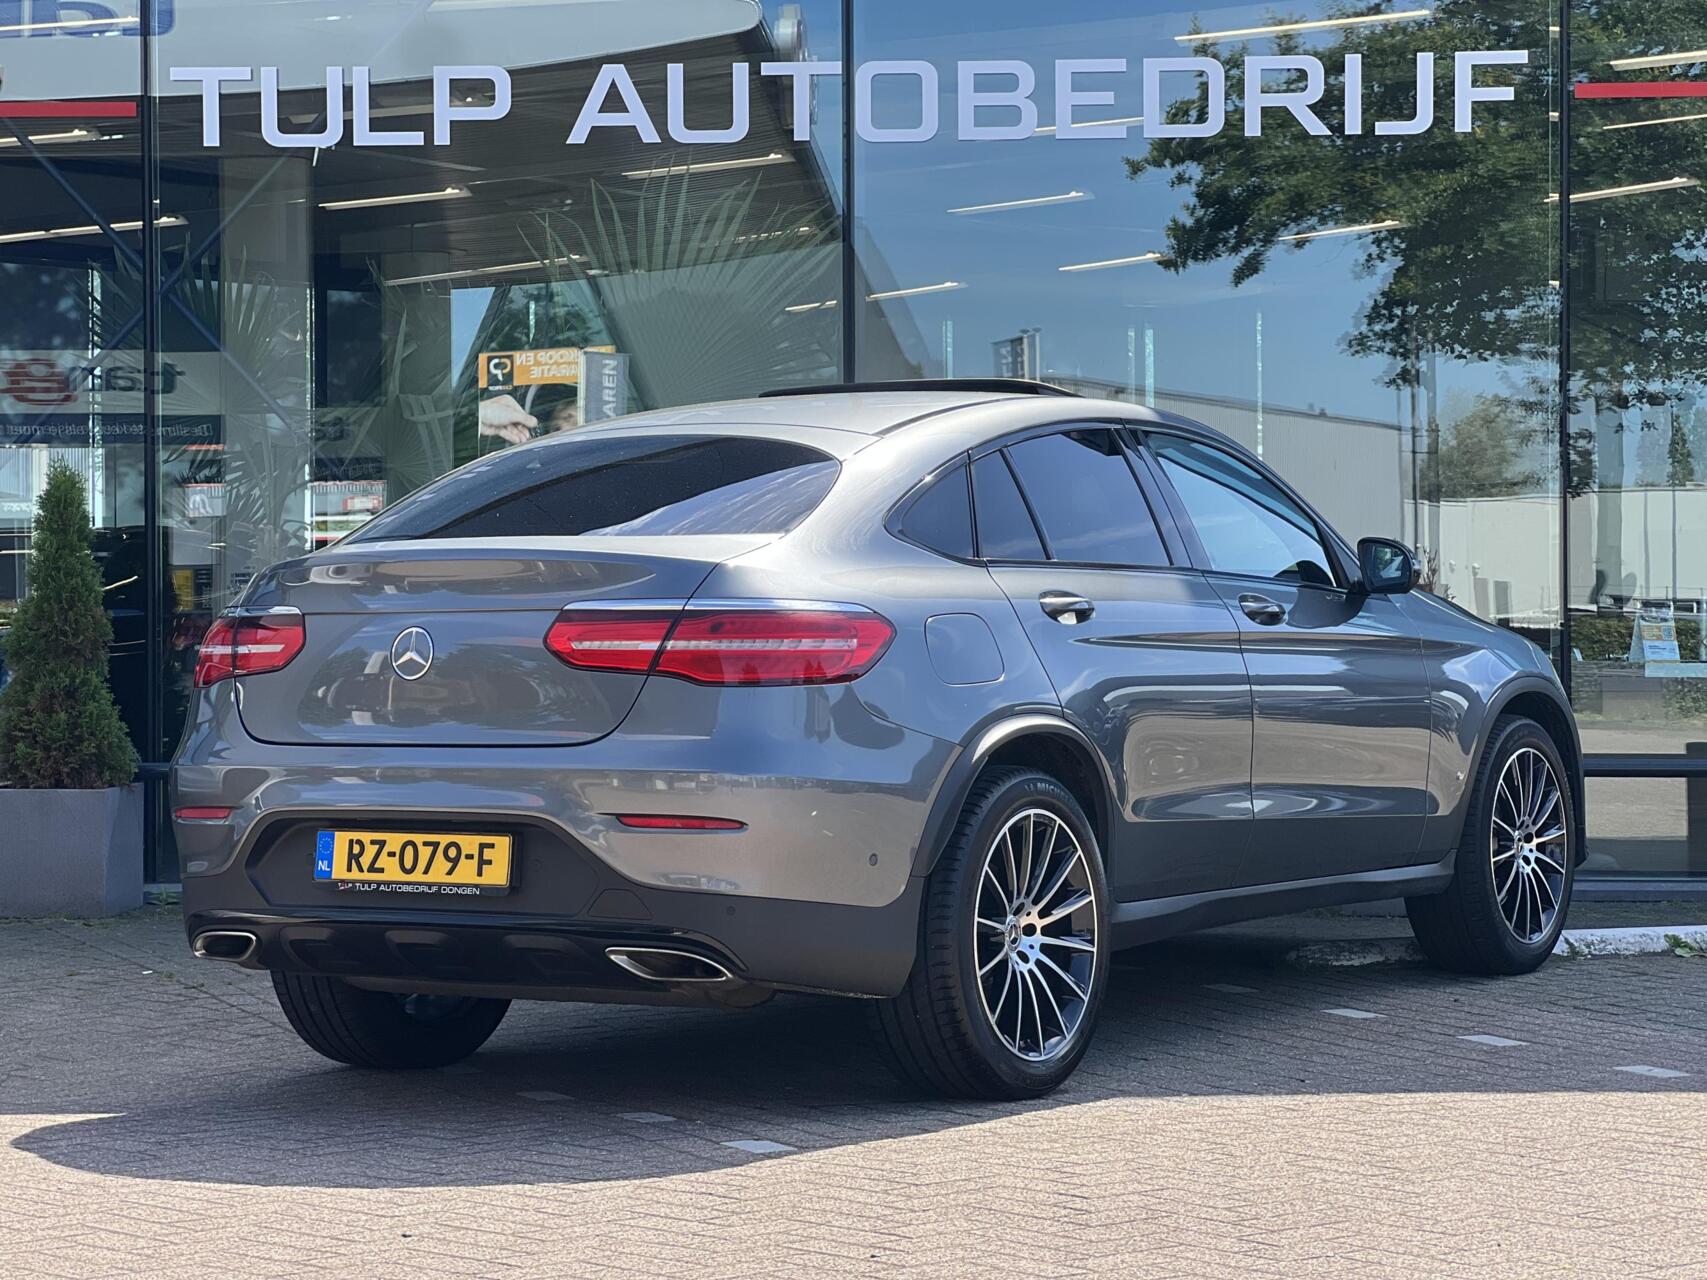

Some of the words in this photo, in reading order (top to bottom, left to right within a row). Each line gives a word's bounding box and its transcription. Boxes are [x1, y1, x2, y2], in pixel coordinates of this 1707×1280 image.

[170, 66, 512, 147] TULP
[566, 50, 1529, 144] AUTOBEDRIJF
[318, 860, 330, 871] NL
[346, 838, 495, 877] RZ-079-F
[355, 882, 377, 891] TULP
[379, 884, 438, 893] AUTOBEDRIJF
[441, 886, 480, 895] DONGEN
